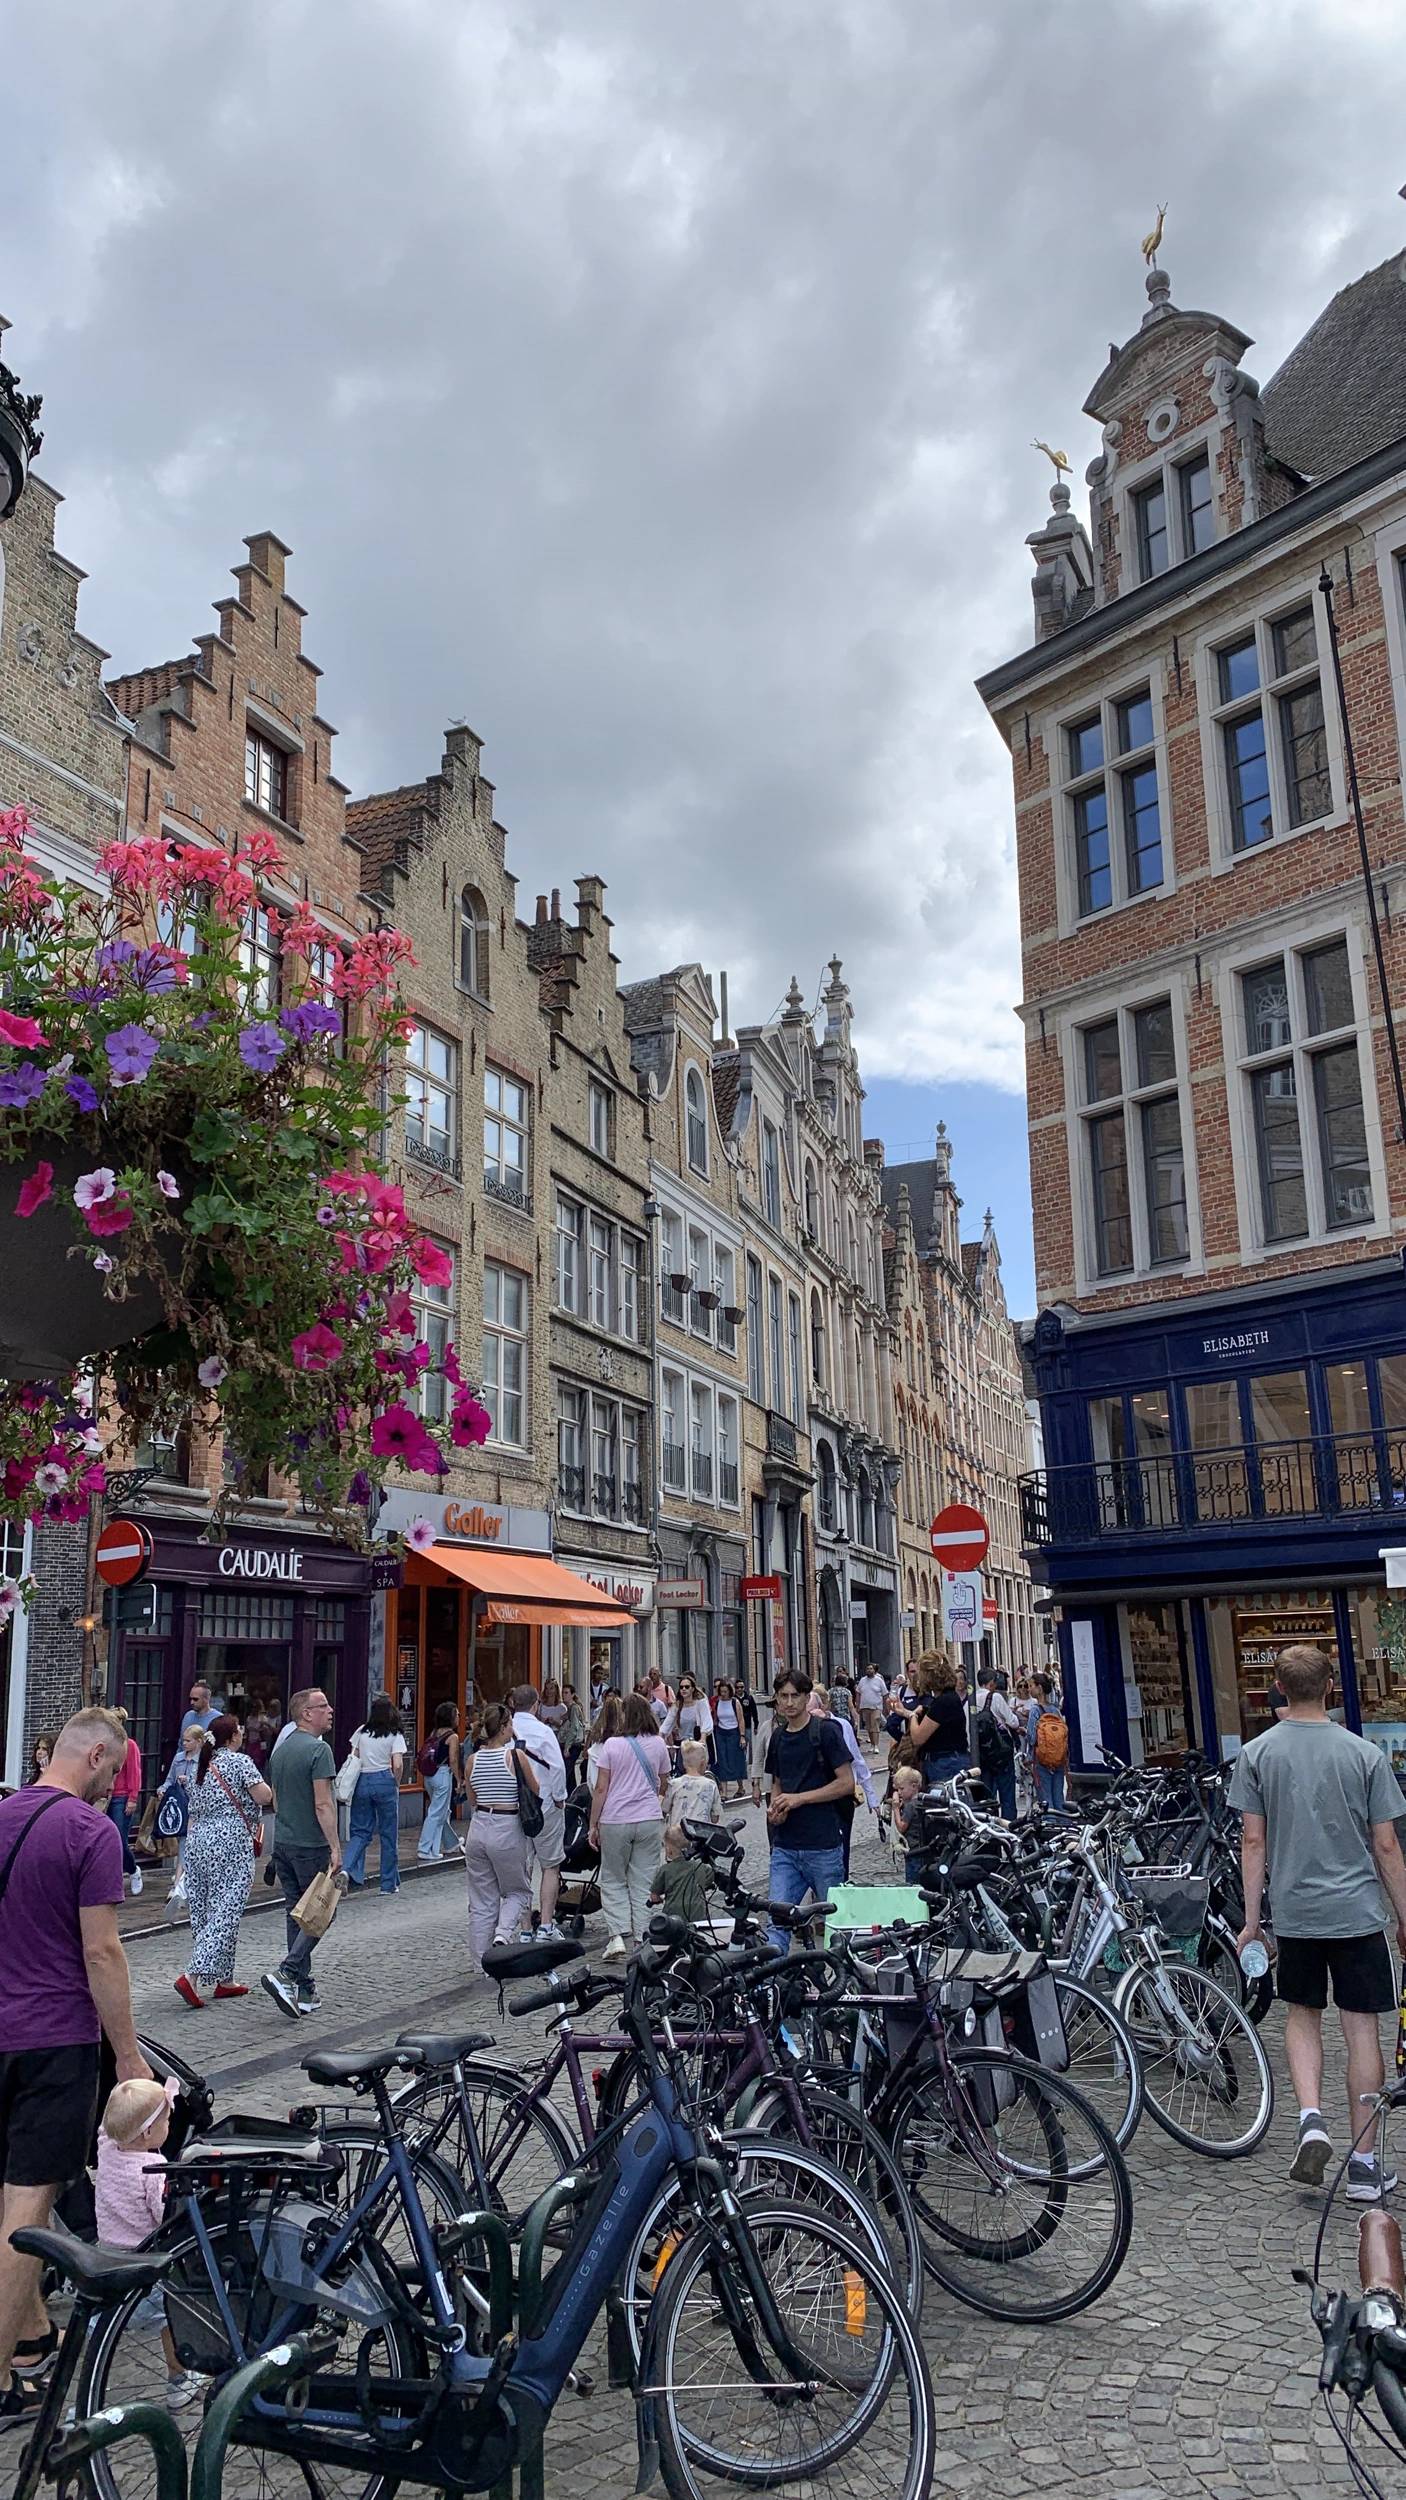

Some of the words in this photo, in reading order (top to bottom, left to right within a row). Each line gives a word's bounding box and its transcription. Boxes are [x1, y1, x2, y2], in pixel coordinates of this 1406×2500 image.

[444, 1503, 502, 1538] Galler
[376, 1577, 395, 1588] SPA
[660, 1591, 674, 1599] Foot
[675, 1590, 699, 1598] Locker
[580, 2184, 630, 2277] Gazelle
